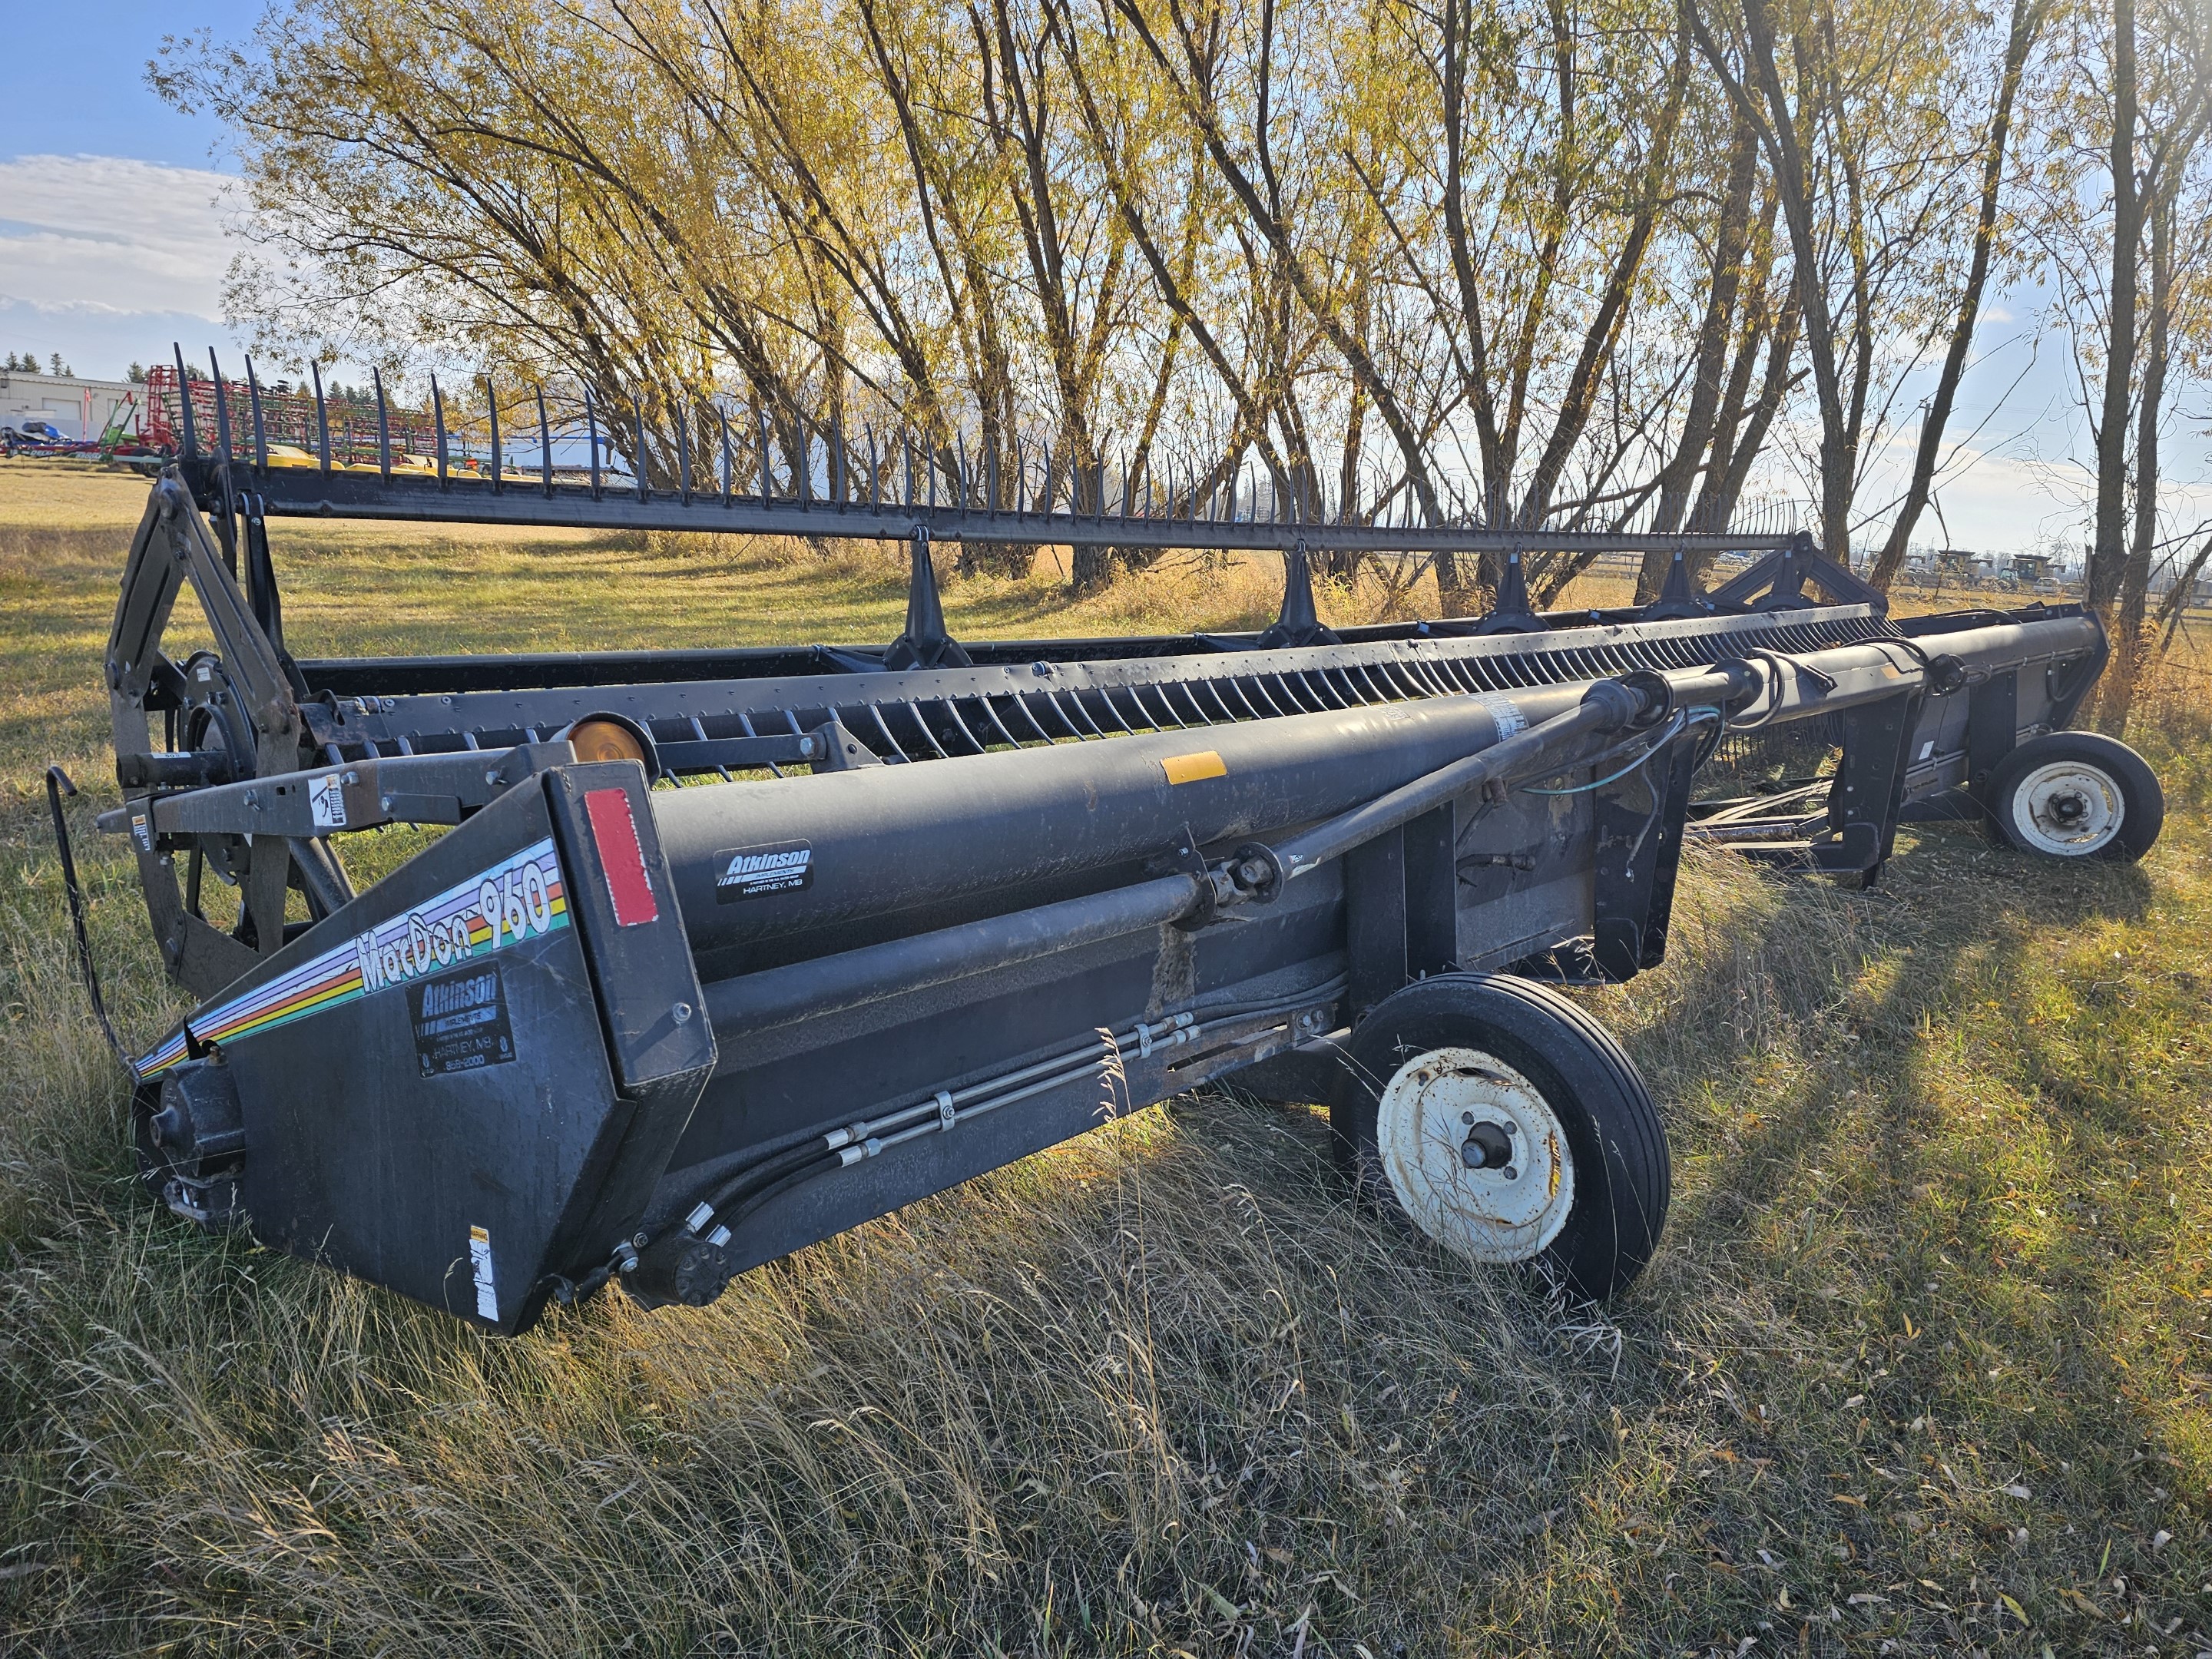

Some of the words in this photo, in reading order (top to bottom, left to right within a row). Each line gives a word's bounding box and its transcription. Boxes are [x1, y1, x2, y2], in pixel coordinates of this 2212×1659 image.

[727, 849, 811, 876] Atkinson
[756, 868, 794, 878] IMPLEMENTS
[743, 882, 786, 894] HARTNEY,
[788, 879, 803, 888] MB
[356, 912, 473, 993] MacDon
[480, 860, 551, 950] 960
[422, 973, 497, 1018] Atkinson
